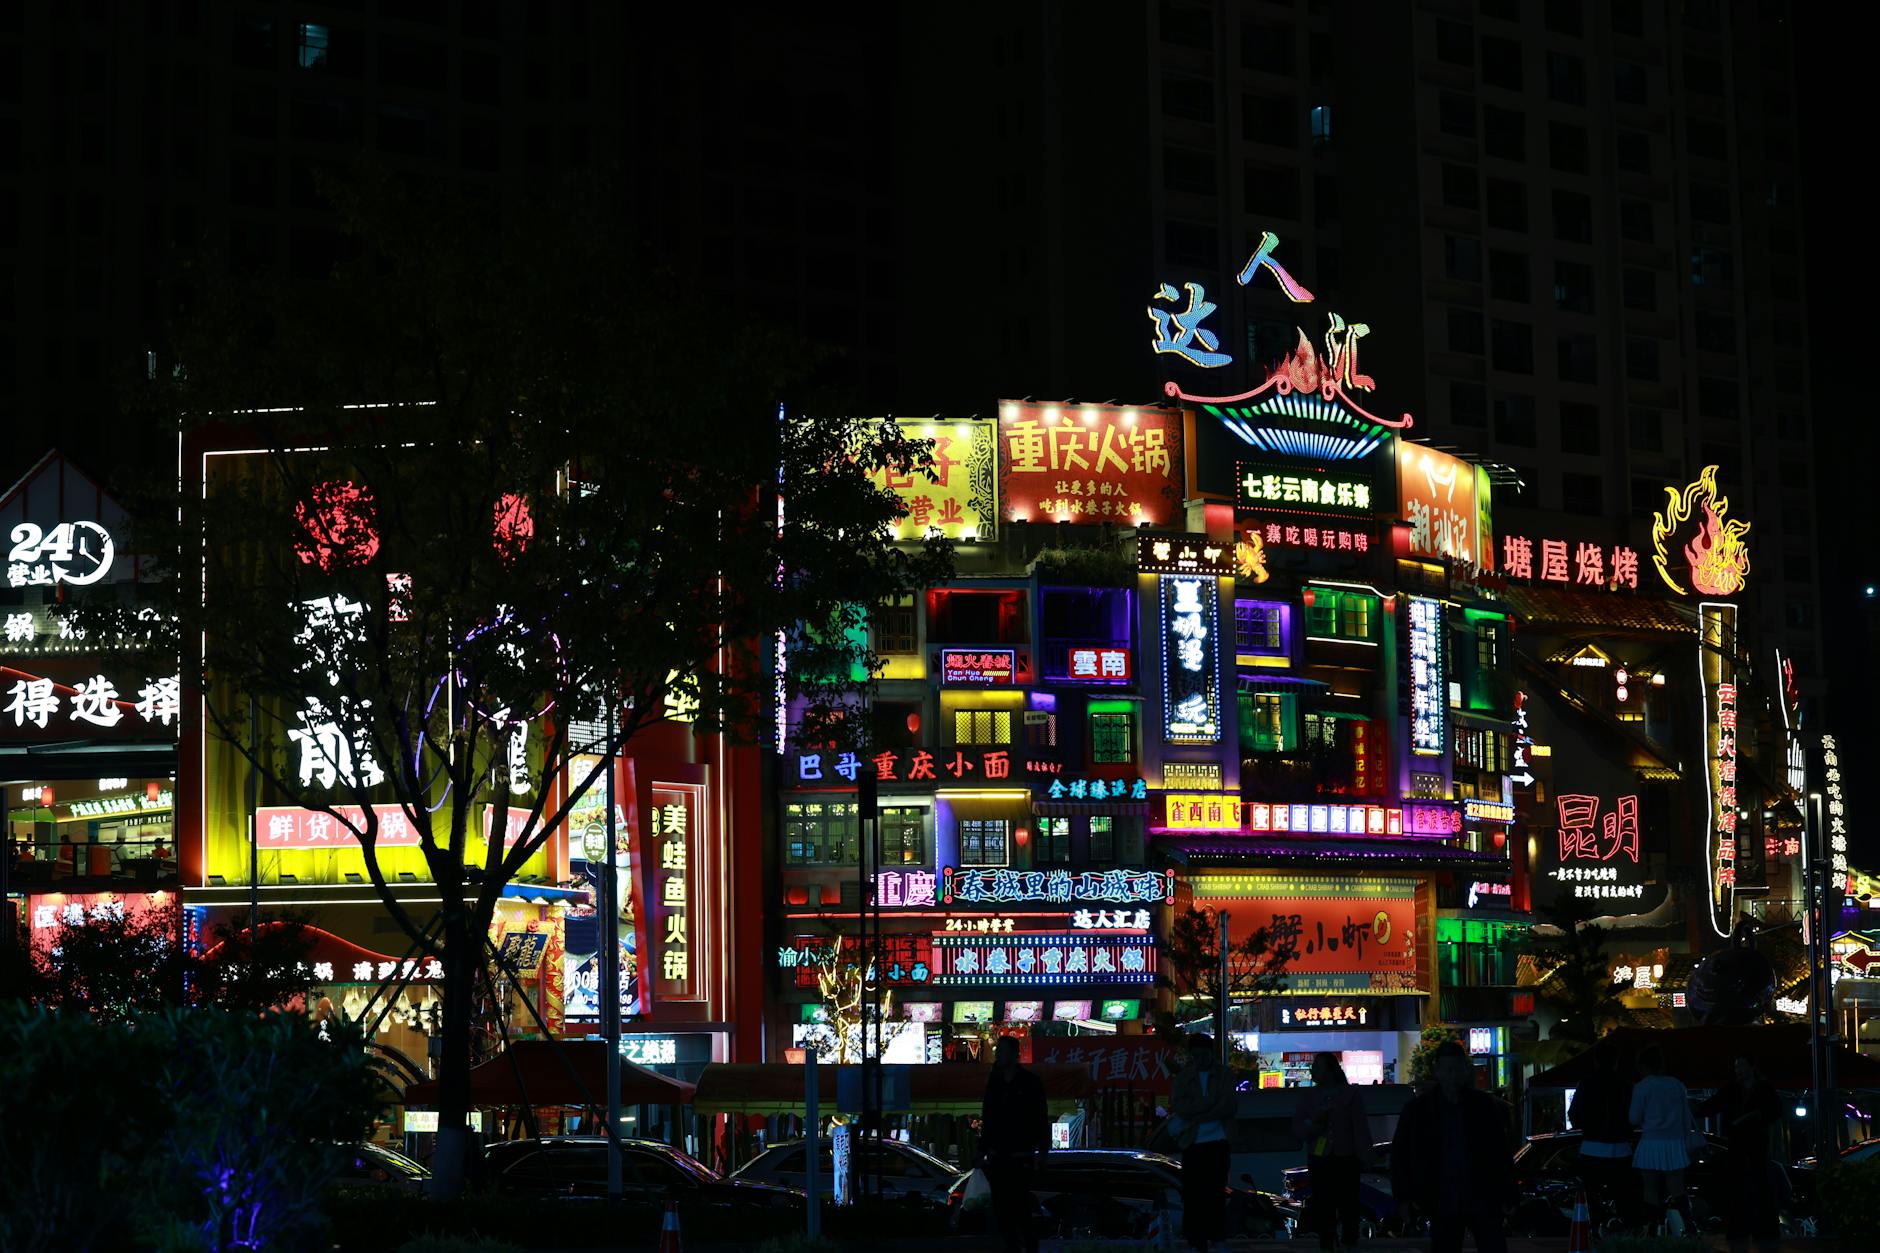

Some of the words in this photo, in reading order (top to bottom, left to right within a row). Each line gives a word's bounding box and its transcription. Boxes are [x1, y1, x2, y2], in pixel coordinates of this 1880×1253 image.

[1005, 416, 1171, 478] 重庆火锅
[1055, 480, 1128, 498] 让更多的人
[1242, 473, 1370, 508] 七彩云南食乐寨
[1038, 500, 1143, 518] 吃到水巷子火锅
[7, 563, 53, 587] 营业
[1503, 535, 1639, 589] 塘屋烧烤
[1073, 650, 1126, 677] 雲南
[3, 674, 179, 729] 得选择
[1557, 794, 1639, 863] 昆明
[1821, 735, 1848, 890] 云南必吃的火塘烧烤
[663, 804, 688, 980] 美蛙鱼火锅
[962, 870, 1160, 901] 春城里的山城味
[1072, 908, 1151, 929] 达人汇店
[956, 947, 1146, 974] 水巷子重庆火锅
